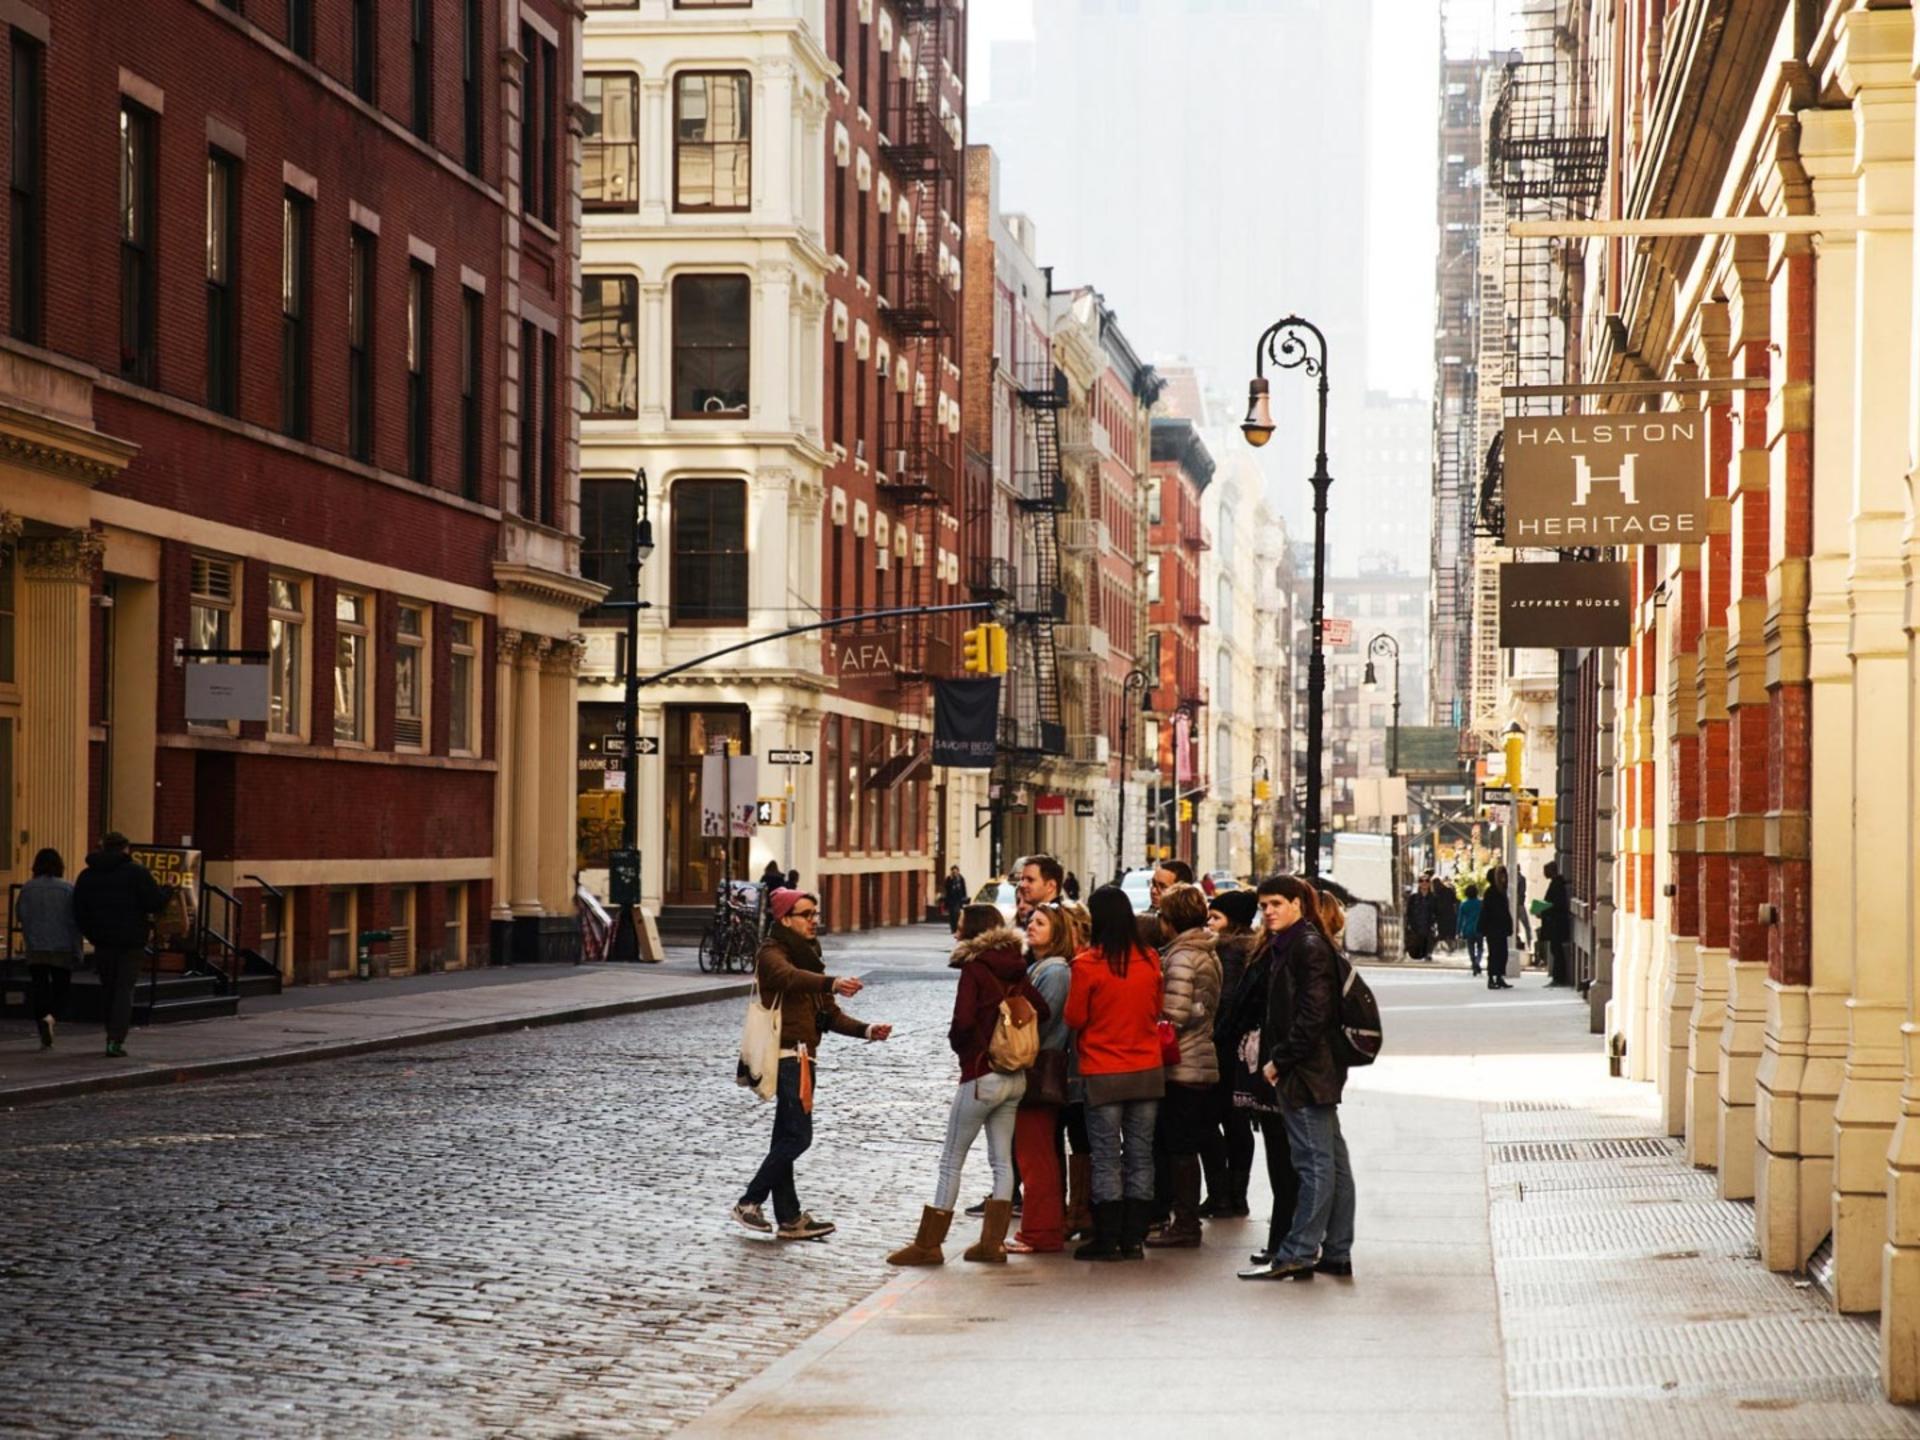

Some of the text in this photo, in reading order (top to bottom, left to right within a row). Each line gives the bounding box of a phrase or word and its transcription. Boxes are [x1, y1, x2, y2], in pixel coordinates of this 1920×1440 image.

[1517, 423, 1694, 445] HALSTON
[1571, 453, 1640, 506] H
[1518, 514, 1695, 536] HERITAGE
[1511, 597, 1620, 608] JEFFREY RÜDES
[841, 645, 891, 670] AFA
[131, 851, 180, 869] STEP
[150, 870, 194, 889] SIDE
